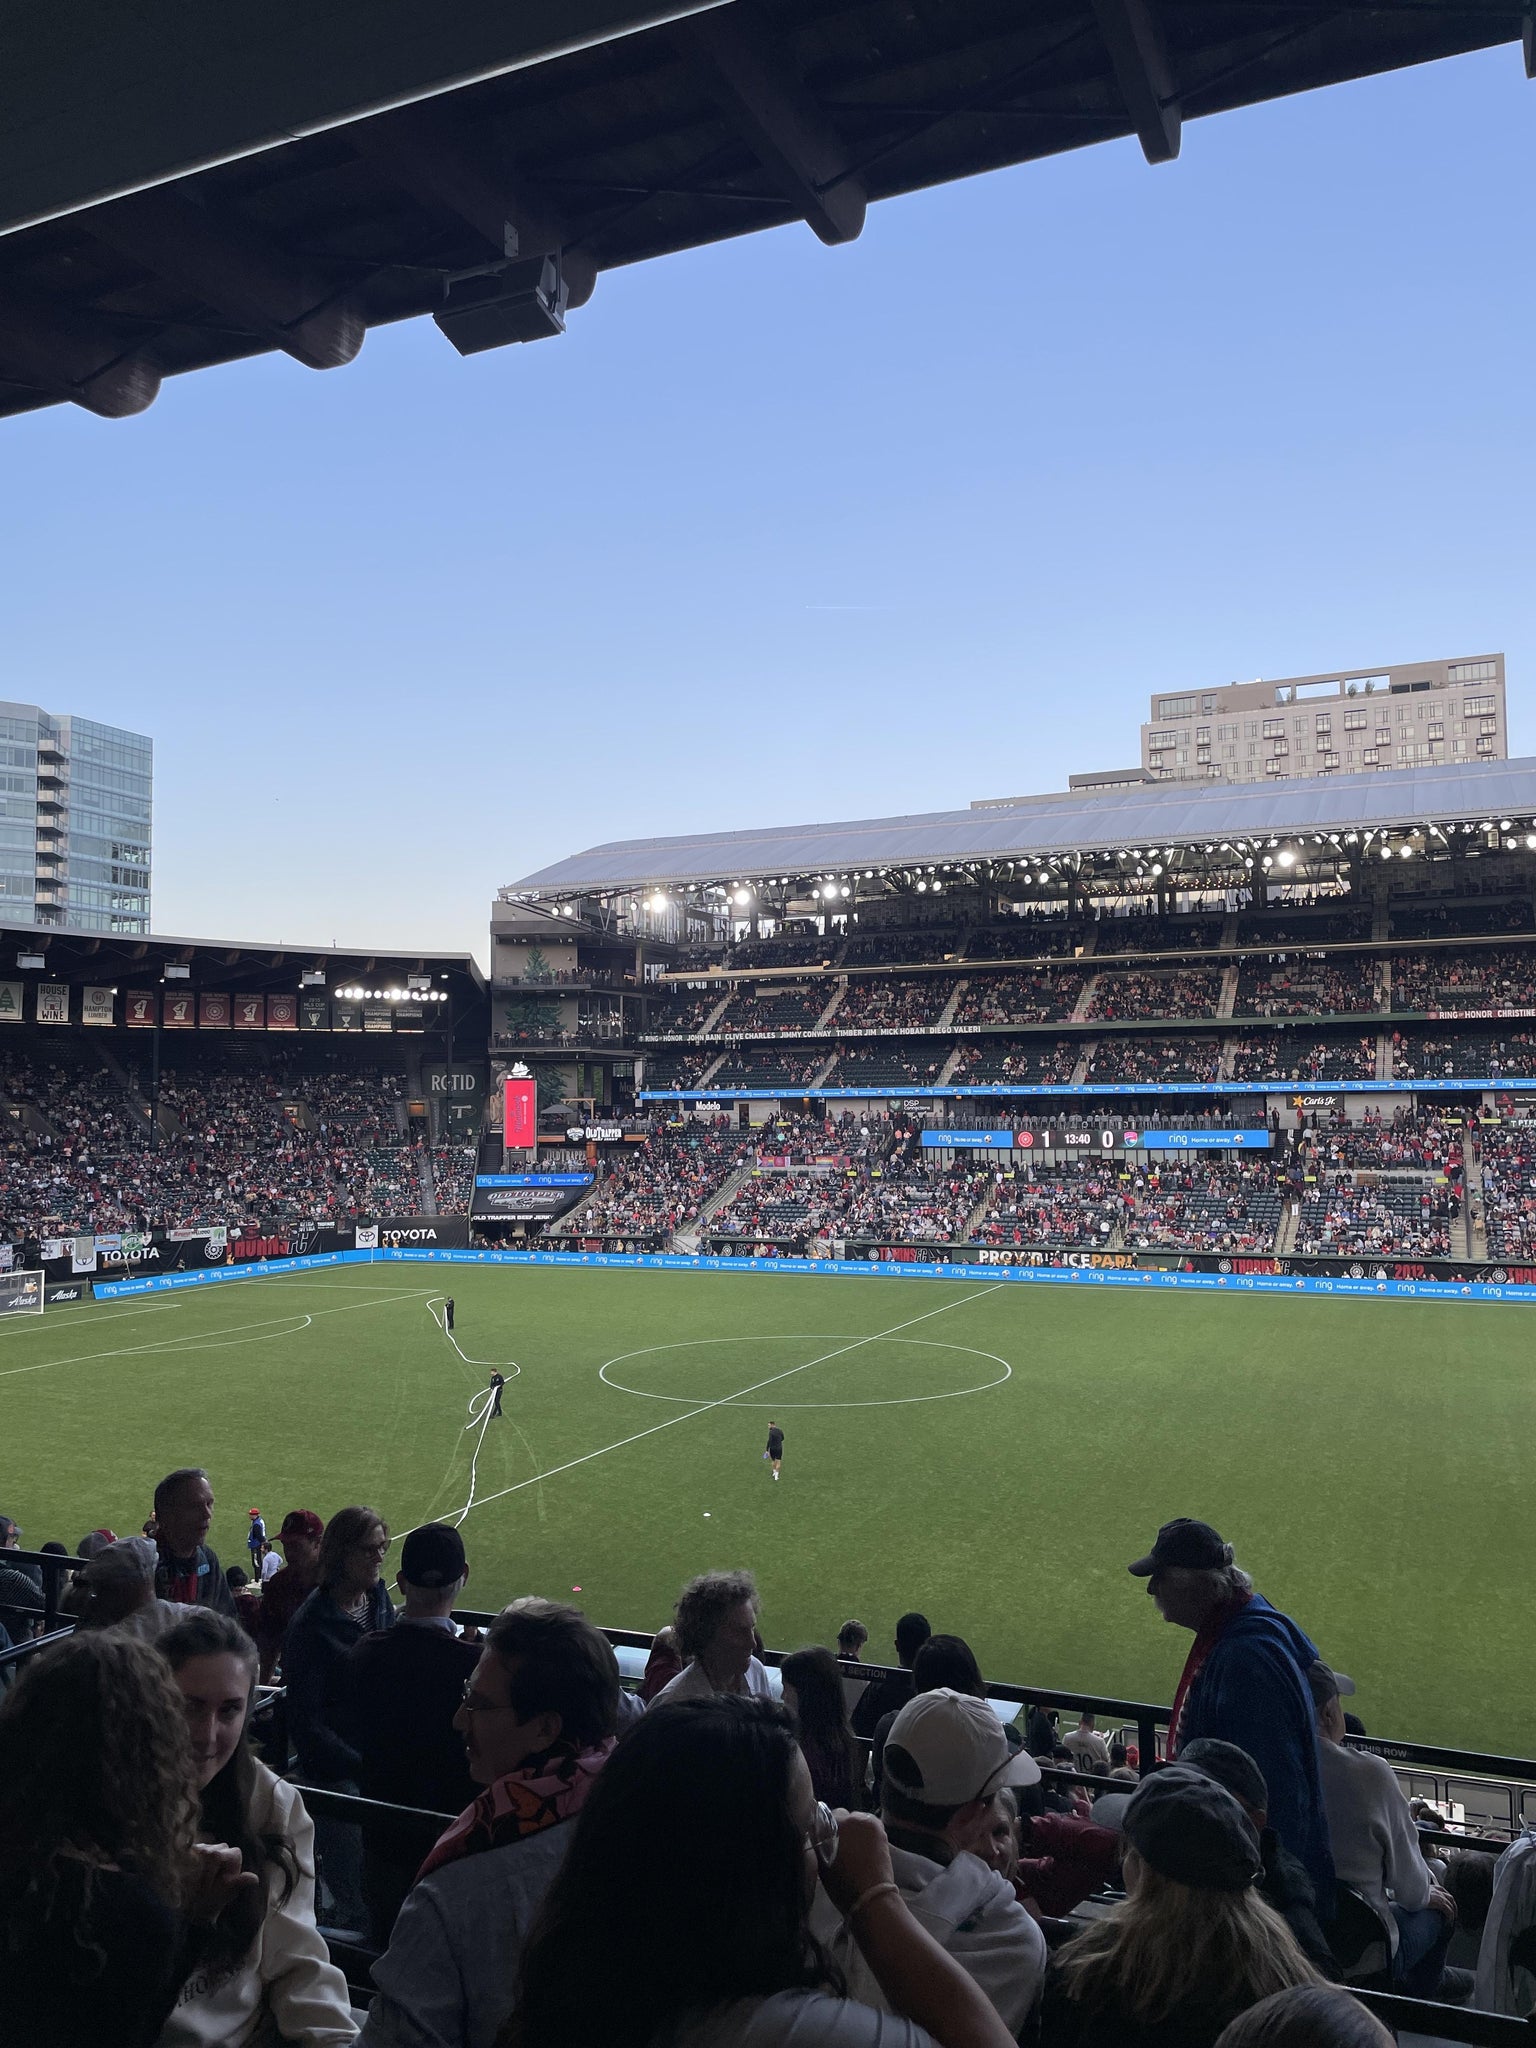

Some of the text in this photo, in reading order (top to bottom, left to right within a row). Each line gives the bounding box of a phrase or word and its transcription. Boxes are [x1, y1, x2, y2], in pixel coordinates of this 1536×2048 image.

[40, 984, 66, 995] HOUSE
[42, 1010, 64, 1020] WINE
[1465, 1010, 1492, 1019] HONOR
[1498, 1009, 1536, 1018] CHRISTINE
[696, 1101, 720, 1110] Modelo
[1304, 1097, 1324, 1105] Carl's
[938, 1135, 951, 1144] ring
[1042, 1131, 1049, 1147] 1
[1065, 1134, 1090, 1144] 13:40
[1102, 1131, 1114, 1148] 0
[1169, 1134, 1187, 1145] ring
[514, 1190, 564, 1198] TRAPPER
[383, 1229, 437, 1240] TOYOTA
[102, 1247, 160, 1261] TOYOTA
[765, 1262, 778, 1270] ring
[825, 1264, 838, 1272] ring
[887, 1266, 900, 1274] ring
[952, 1268, 966, 1276] ring
[1019, 1270, 1034, 1279] ring
[1394, 1264, 1425, 1280] 2012
[1089, 1273, 1104, 1282] ring
[1162, 1275, 1177, 1285] ring
[1237, 1278, 1253, 1288] ring
[1316, 1281, 1332, 1290] ring
[1398, 1284, 1415, 1294] ring
[1483, 1287, 1501, 1297] ring
[50, 1289, 78, 1301] Alaska
[8, 1295, 36, 1307] Alaska
[848, 1666, 887, 1680] SECTION
[1360, 1743, 1382, 1754] THIS
[1383, 1747, 1407, 1758] ROW
[1077, 1754, 1093, 1771] 10
